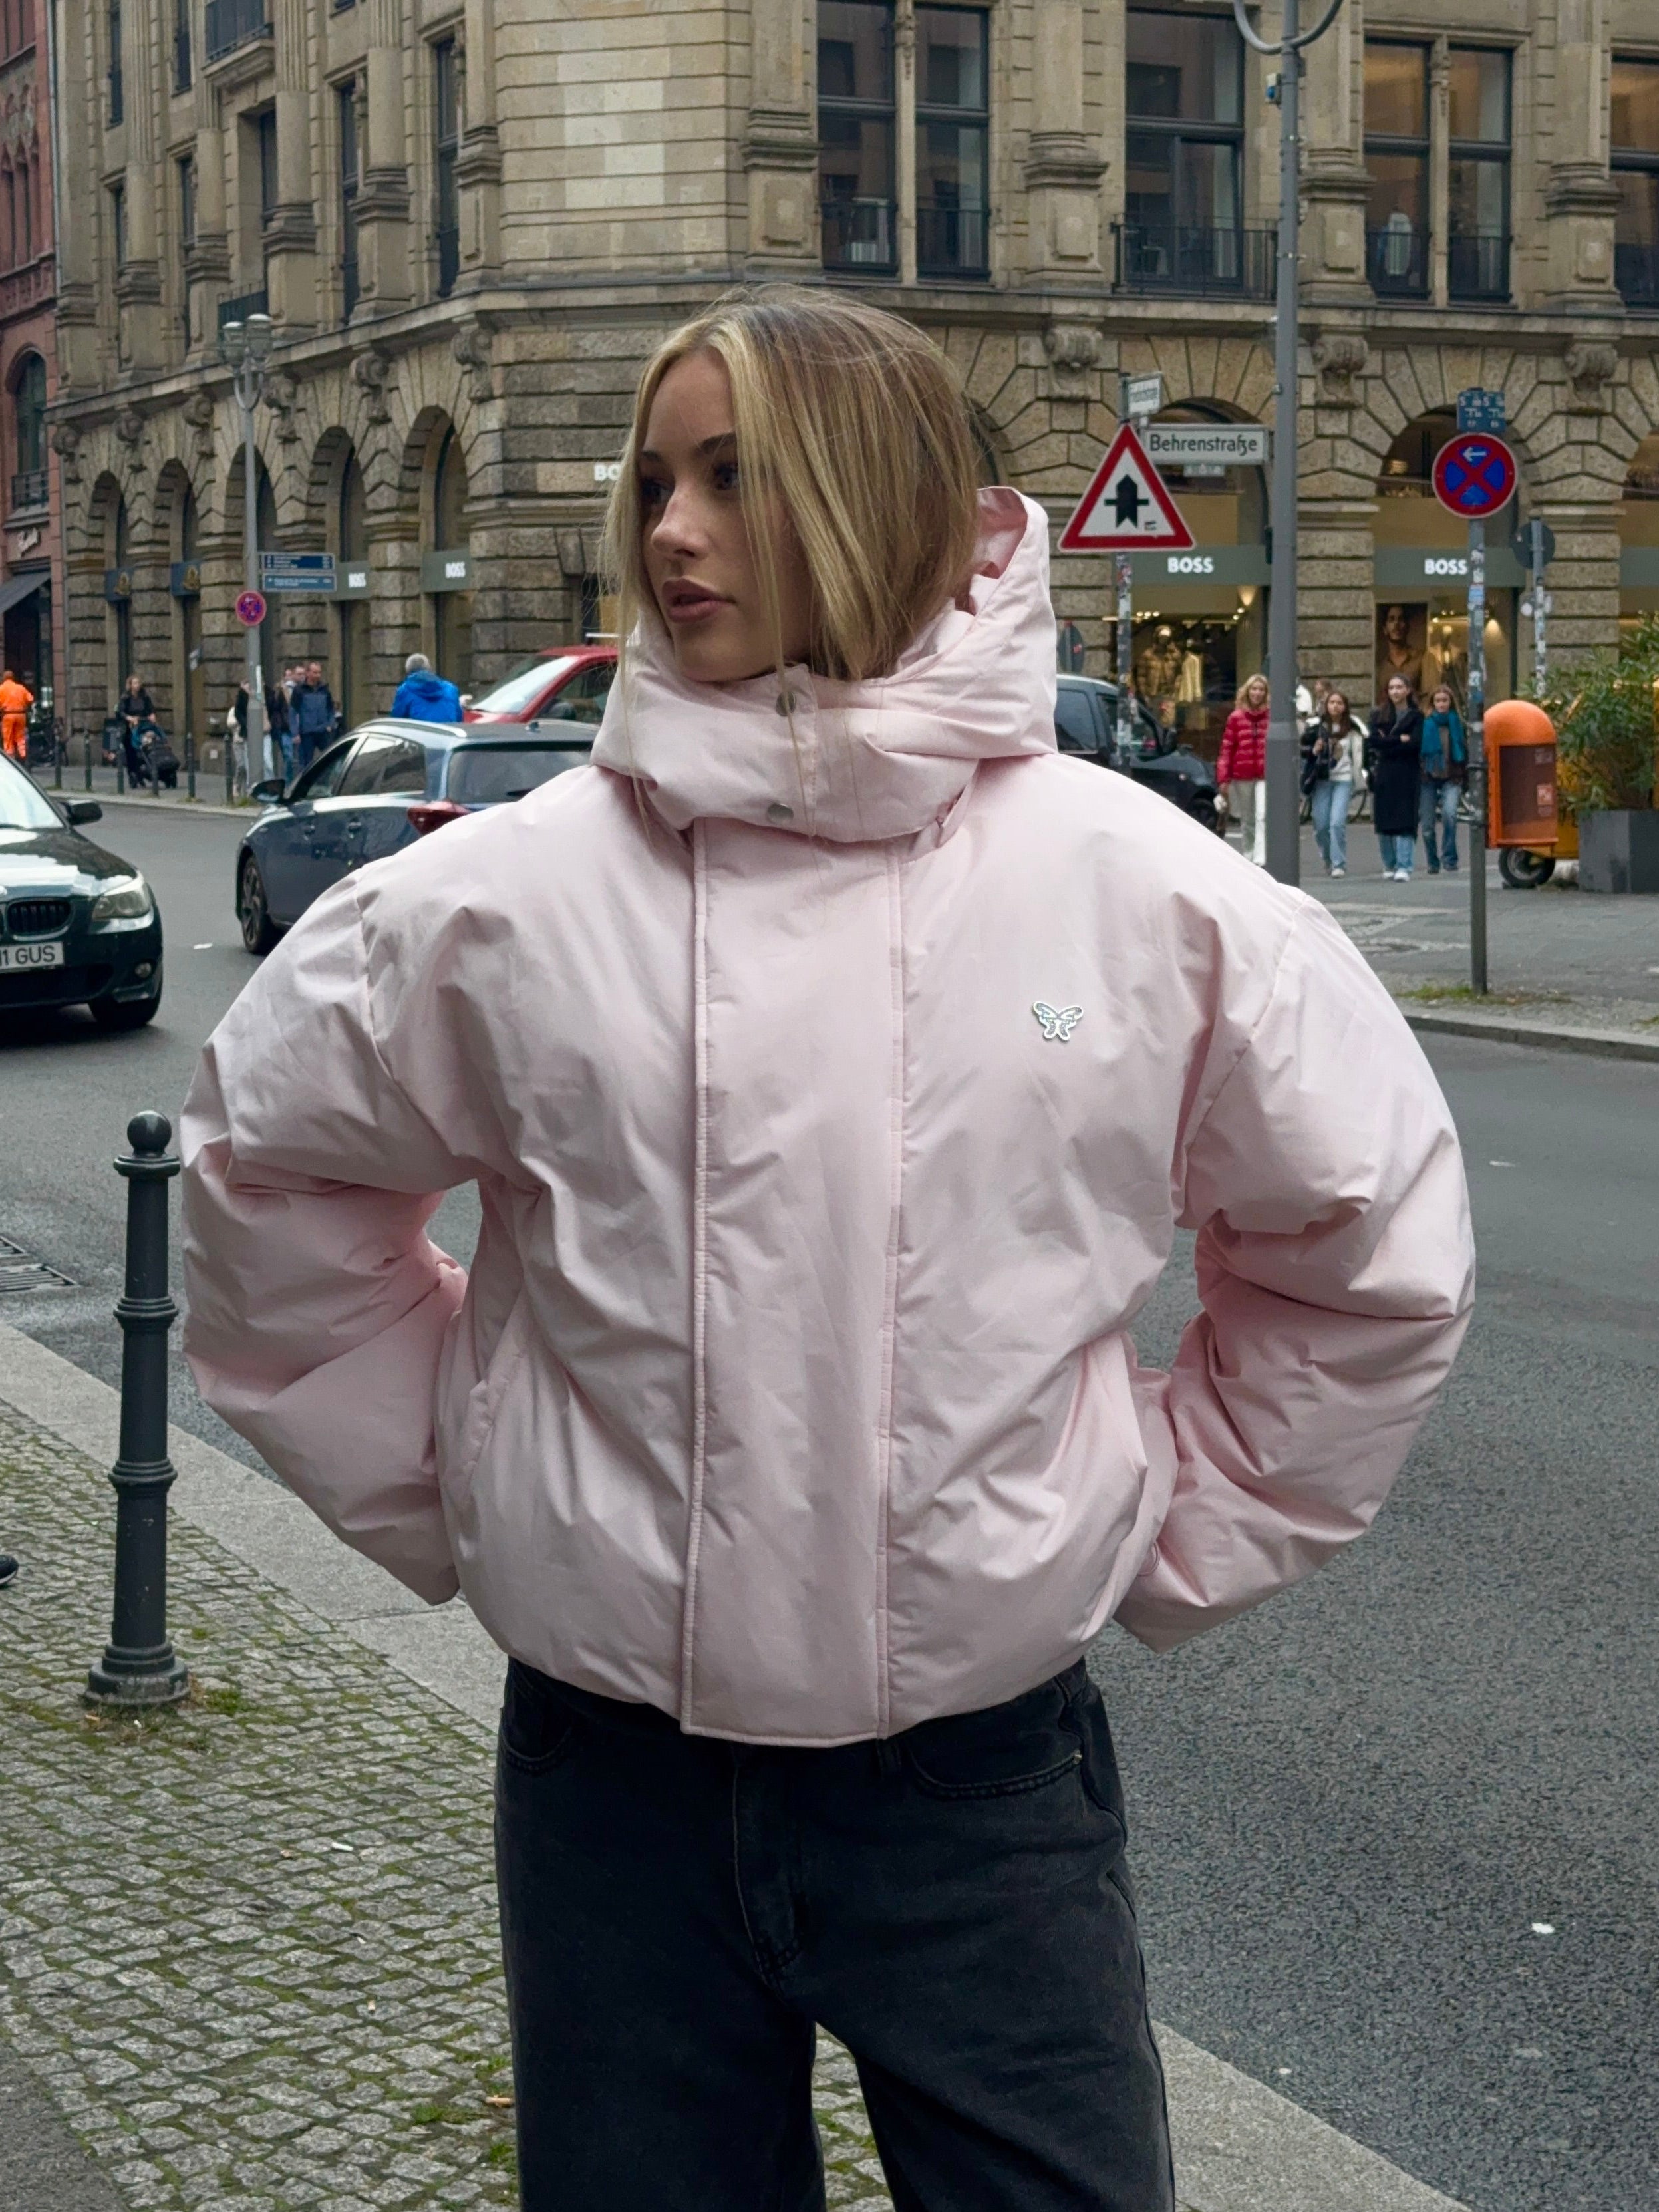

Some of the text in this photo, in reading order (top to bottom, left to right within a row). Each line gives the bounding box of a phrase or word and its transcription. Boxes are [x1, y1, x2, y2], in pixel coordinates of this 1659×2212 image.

[1149, 433, 1257, 456] Behrenstraße
[594, 462, 621, 481] BO
[1167, 557, 1213, 573] BOSS
[1424, 558, 1468, 575] BOSS
[15, 945, 55, 965] GUS
